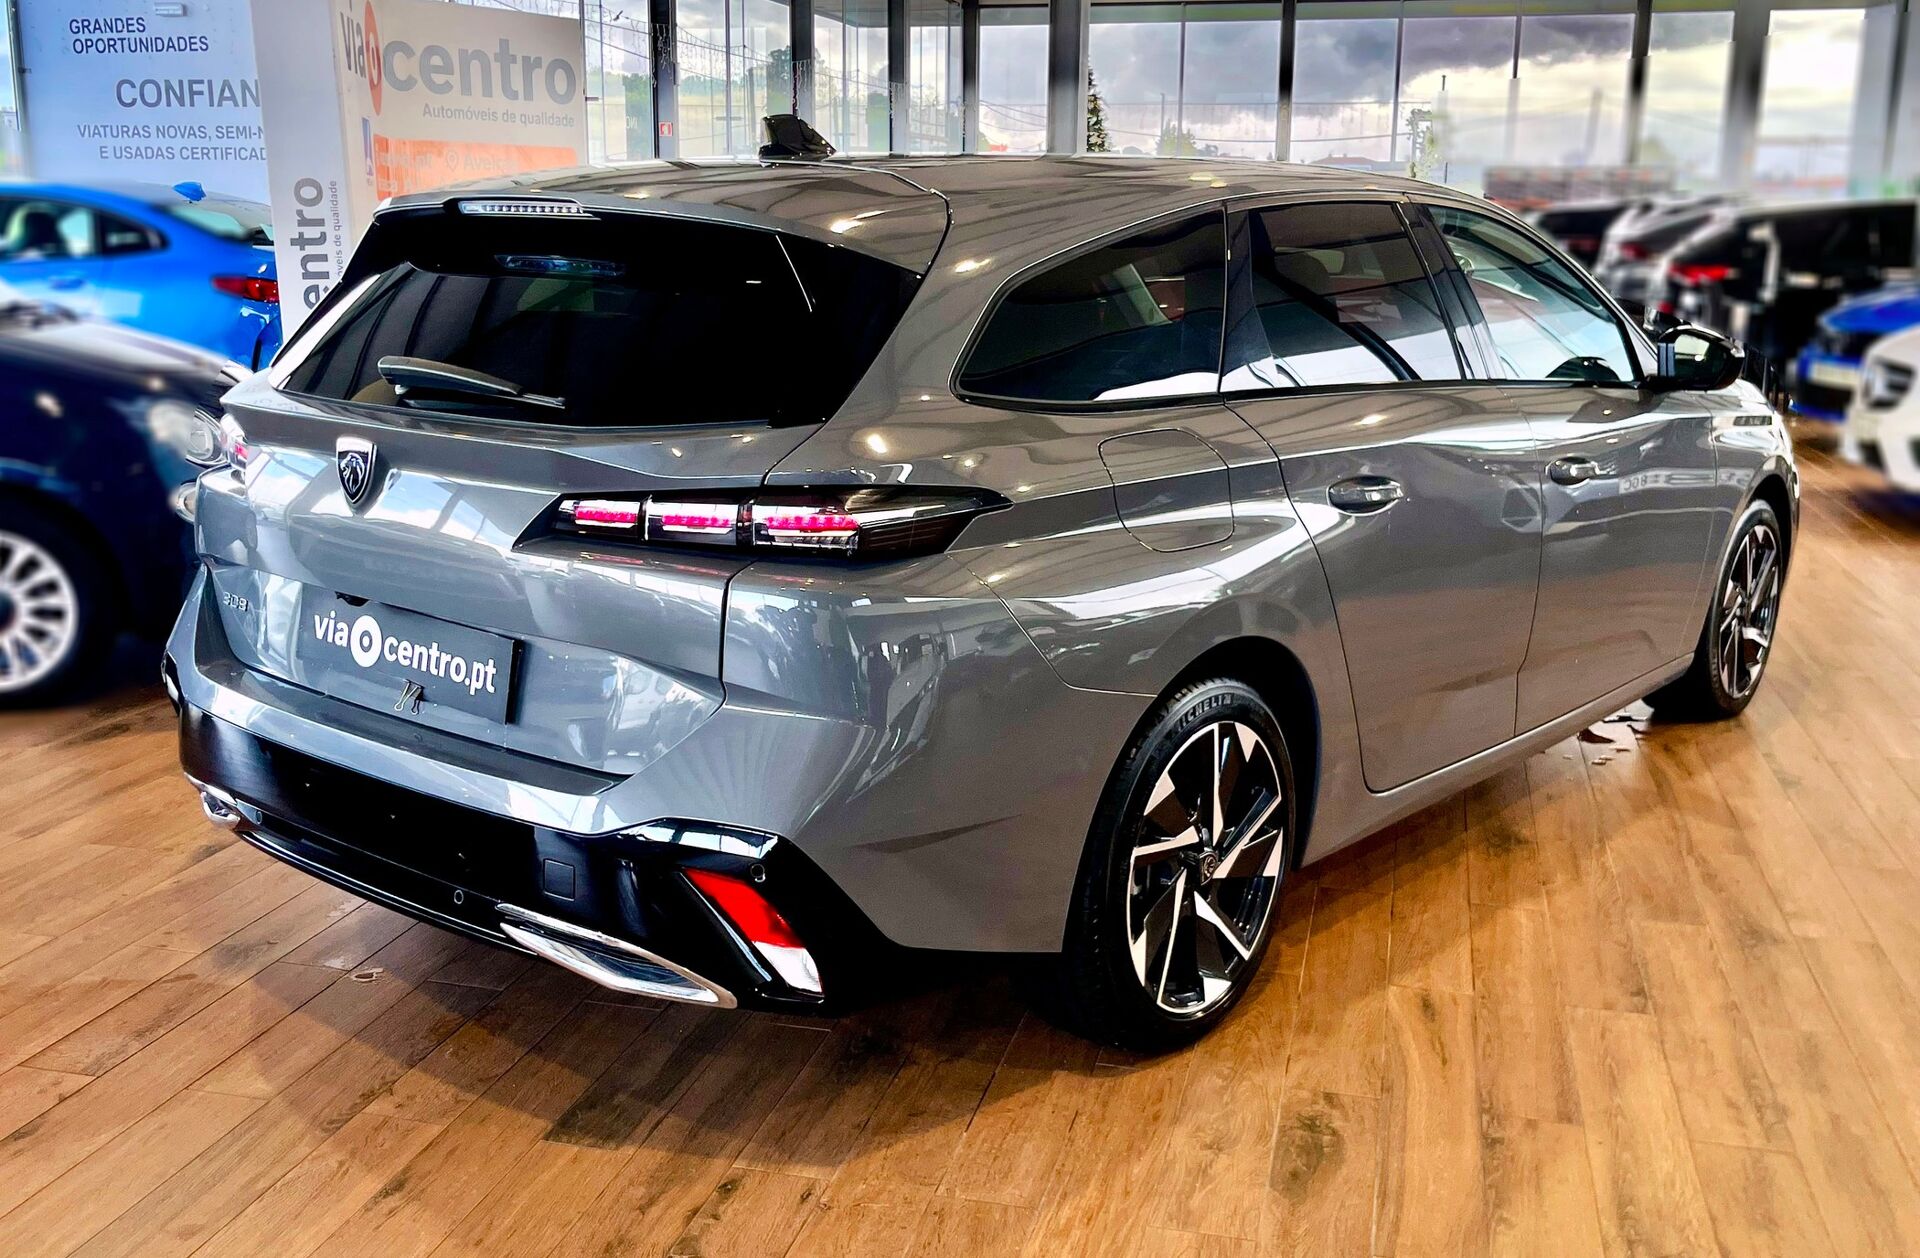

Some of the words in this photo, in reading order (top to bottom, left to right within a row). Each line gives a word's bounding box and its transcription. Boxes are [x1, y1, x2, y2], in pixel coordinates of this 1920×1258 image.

[69, 17, 146, 34] GRANDES
[72, 36, 209, 54] OPORTUNIDADES
[115, 79, 261, 108] CONFIAN
[422, 103, 499, 122] Automóveis
[502, 109, 516, 123] de
[519, 111, 575, 128] qualidade
[77, 125, 151, 138] VIATURAS
[156, 125, 212, 141] NOVAS,
[100, 146, 109, 159] E
[113, 146, 175, 160] USADAS
[328, 181, 343, 231] qualidade
[333, 234, 342, 247] de
